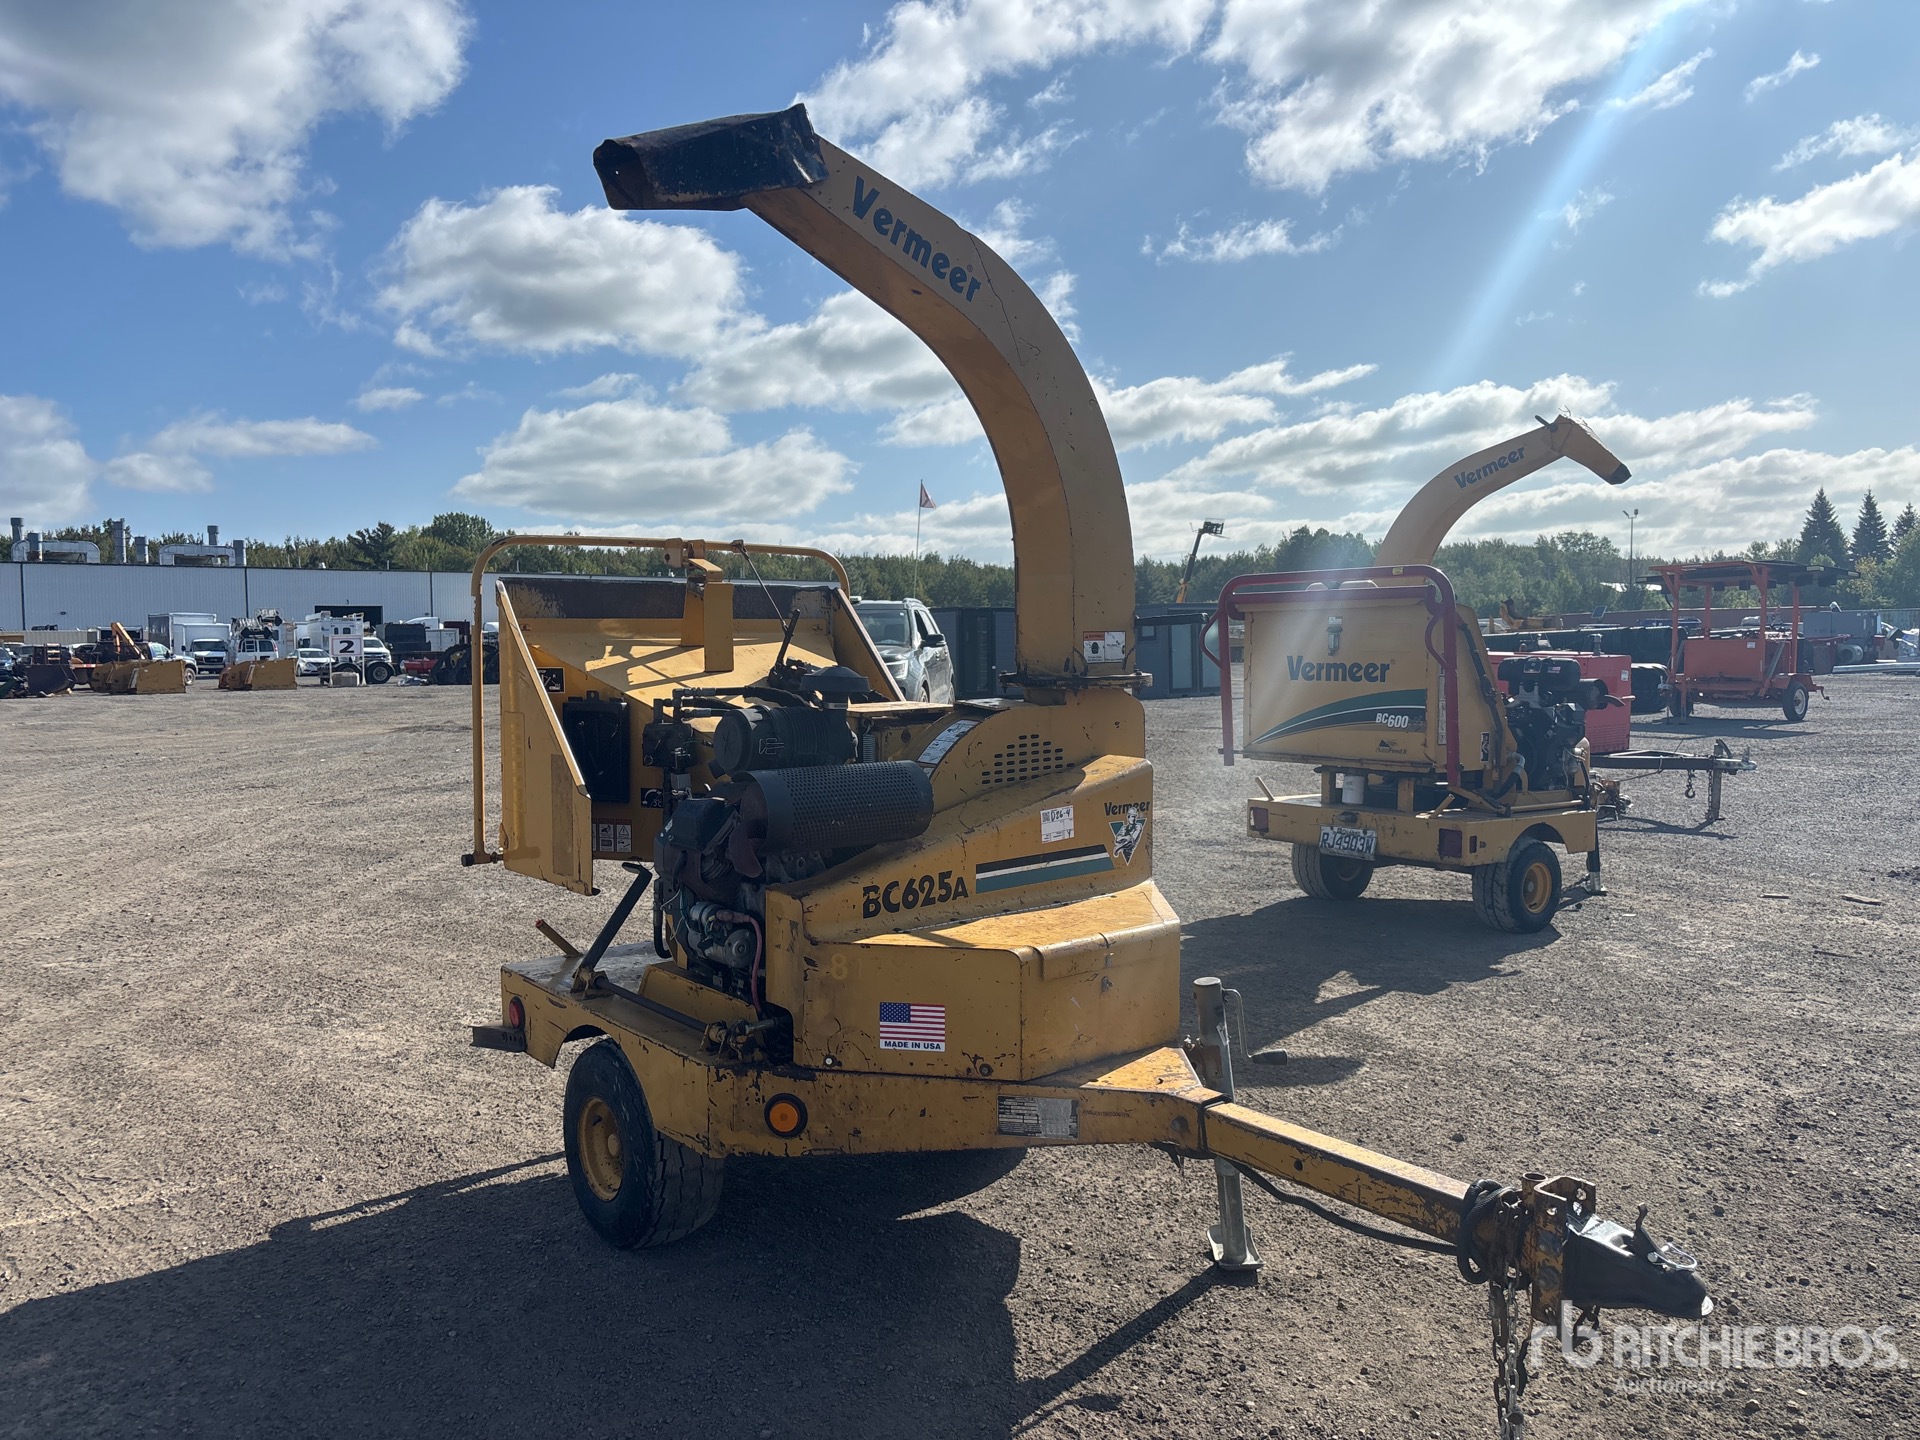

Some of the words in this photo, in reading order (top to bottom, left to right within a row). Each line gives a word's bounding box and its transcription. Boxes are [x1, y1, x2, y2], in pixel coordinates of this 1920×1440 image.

[853, 176, 981, 302] Vermeer
[1454, 446, 1525, 489] Vermeer
[339, 640, 355, 653] 2
[1287, 655, 1390, 682] Vermeer
[1376, 713, 1409, 728] BC600
[1103, 801, 1150, 816] Vermeer
[862, 870, 969, 919] BC625A
[923, 1042, 941, 1050] USA
